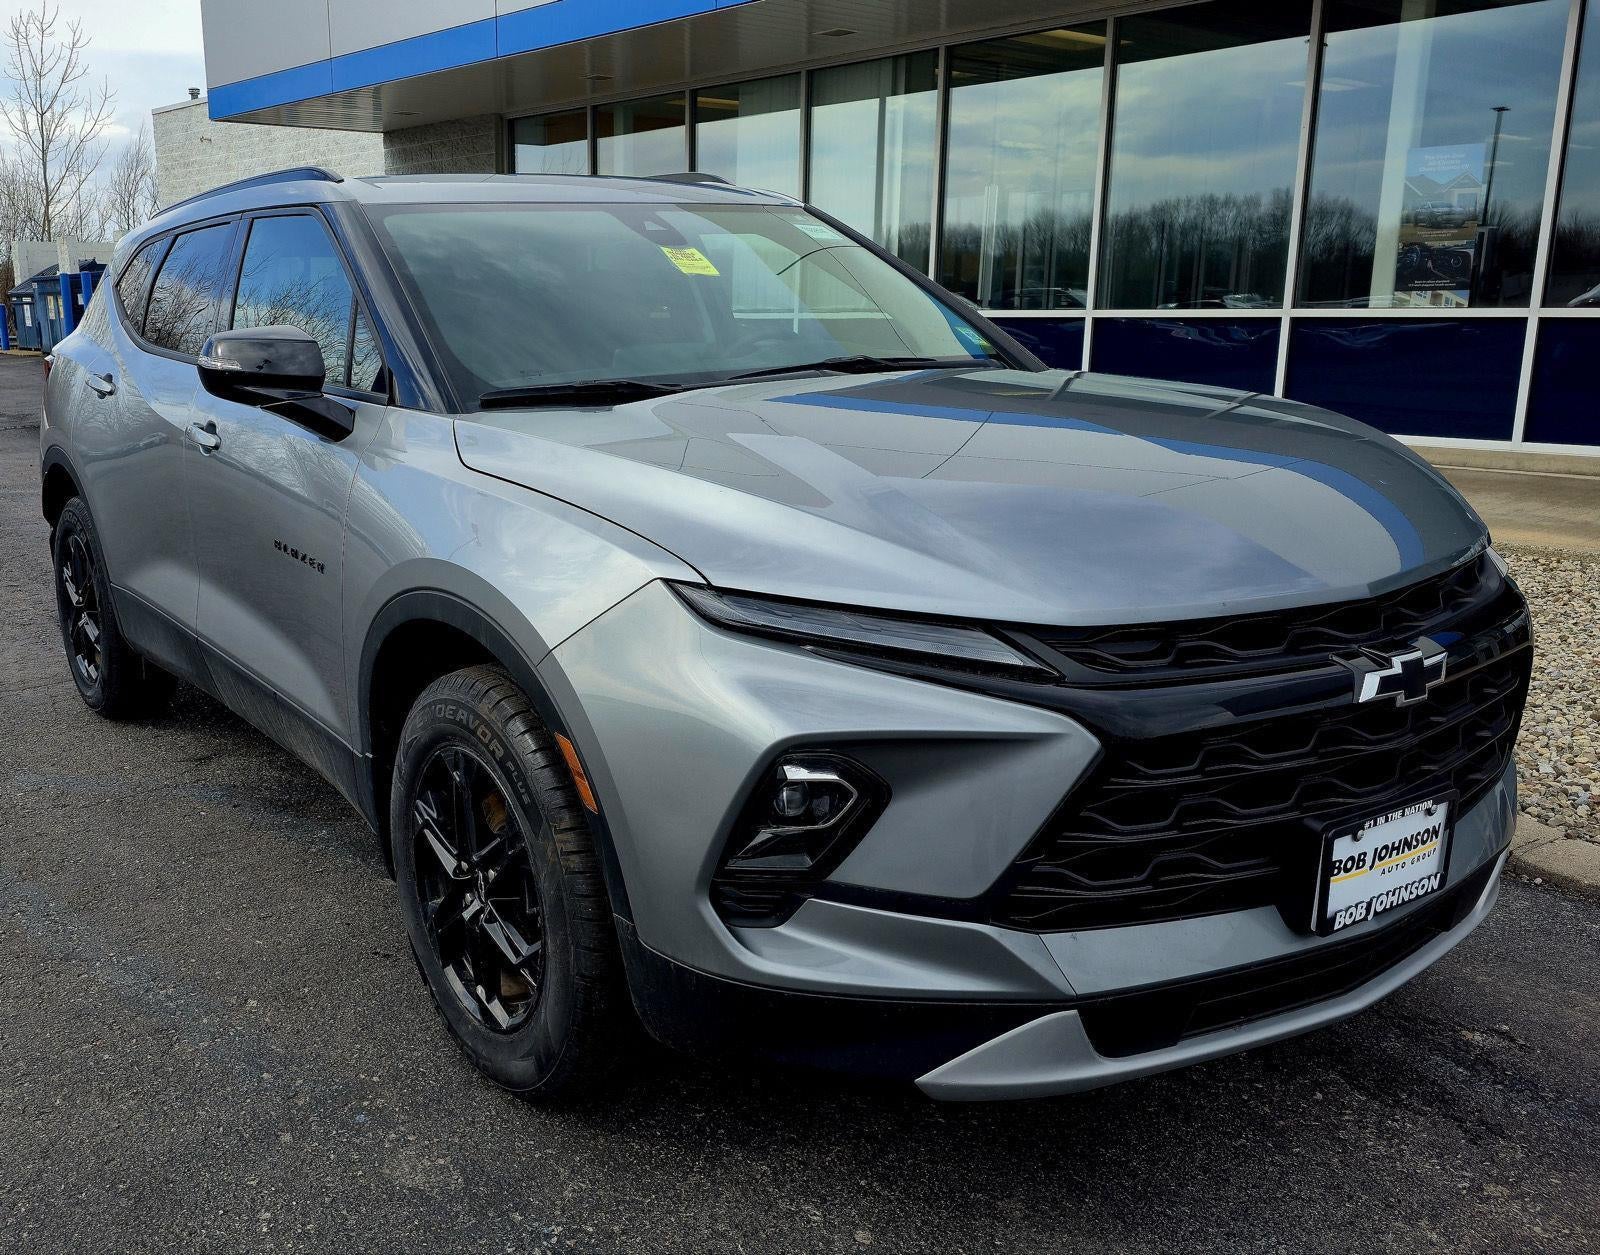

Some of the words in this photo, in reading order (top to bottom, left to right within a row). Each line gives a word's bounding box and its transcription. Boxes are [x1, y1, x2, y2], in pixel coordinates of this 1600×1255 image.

[415, 704, 505, 759] EDEAVOR
[1363, 820, 1375, 830] #1
[1376, 816, 1386, 826] IN
[1387, 809, 1403, 822] THE
[1404, 799, 1434, 816] NATION
[1330, 852, 1368, 878] BOB
[1368, 822, 1442, 871] JOHNSON
[1380, 861, 1407, 876] AUTO
[1410, 847, 1437, 865] GROUP
[1333, 901, 1368, 931] BOB
[1367, 872, 1441, 920] JOHNSON
